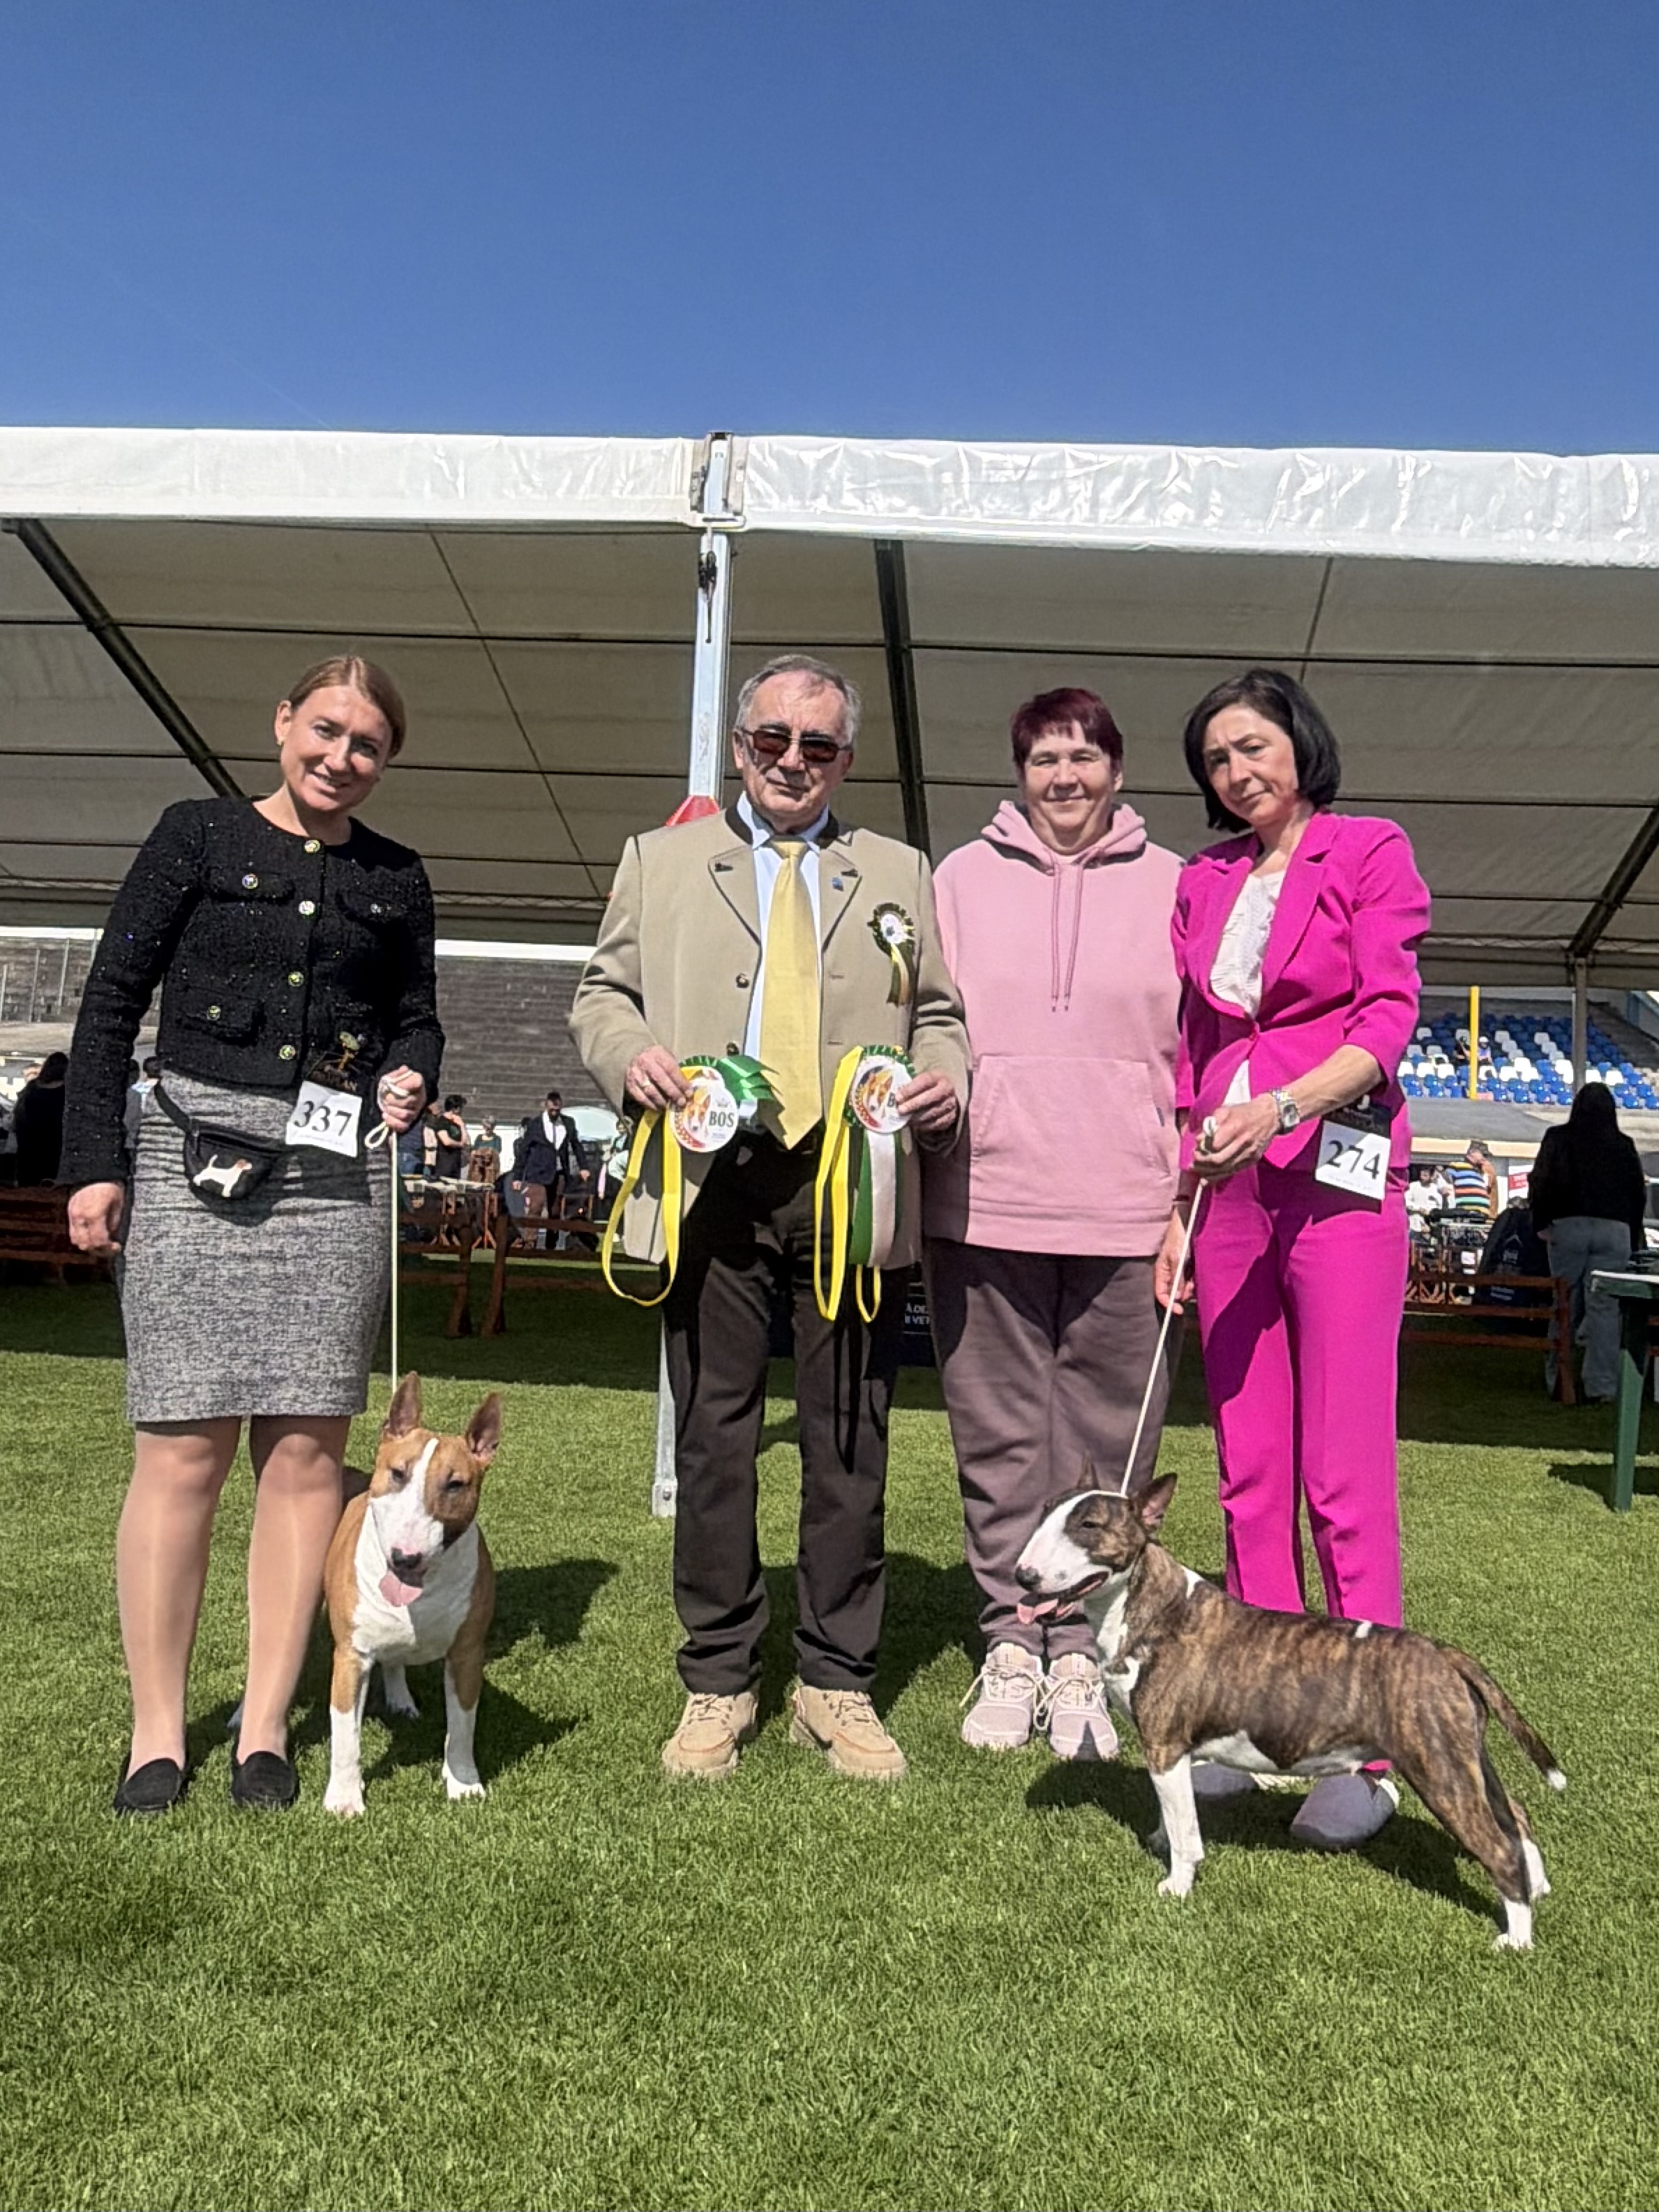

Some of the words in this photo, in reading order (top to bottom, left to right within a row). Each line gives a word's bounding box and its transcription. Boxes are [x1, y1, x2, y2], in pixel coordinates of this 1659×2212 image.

[294, 1101, 352, 1136] 337
[709, 1110, 735, 1128] BOS
[1326, 1140, 1381, 1180] 274
